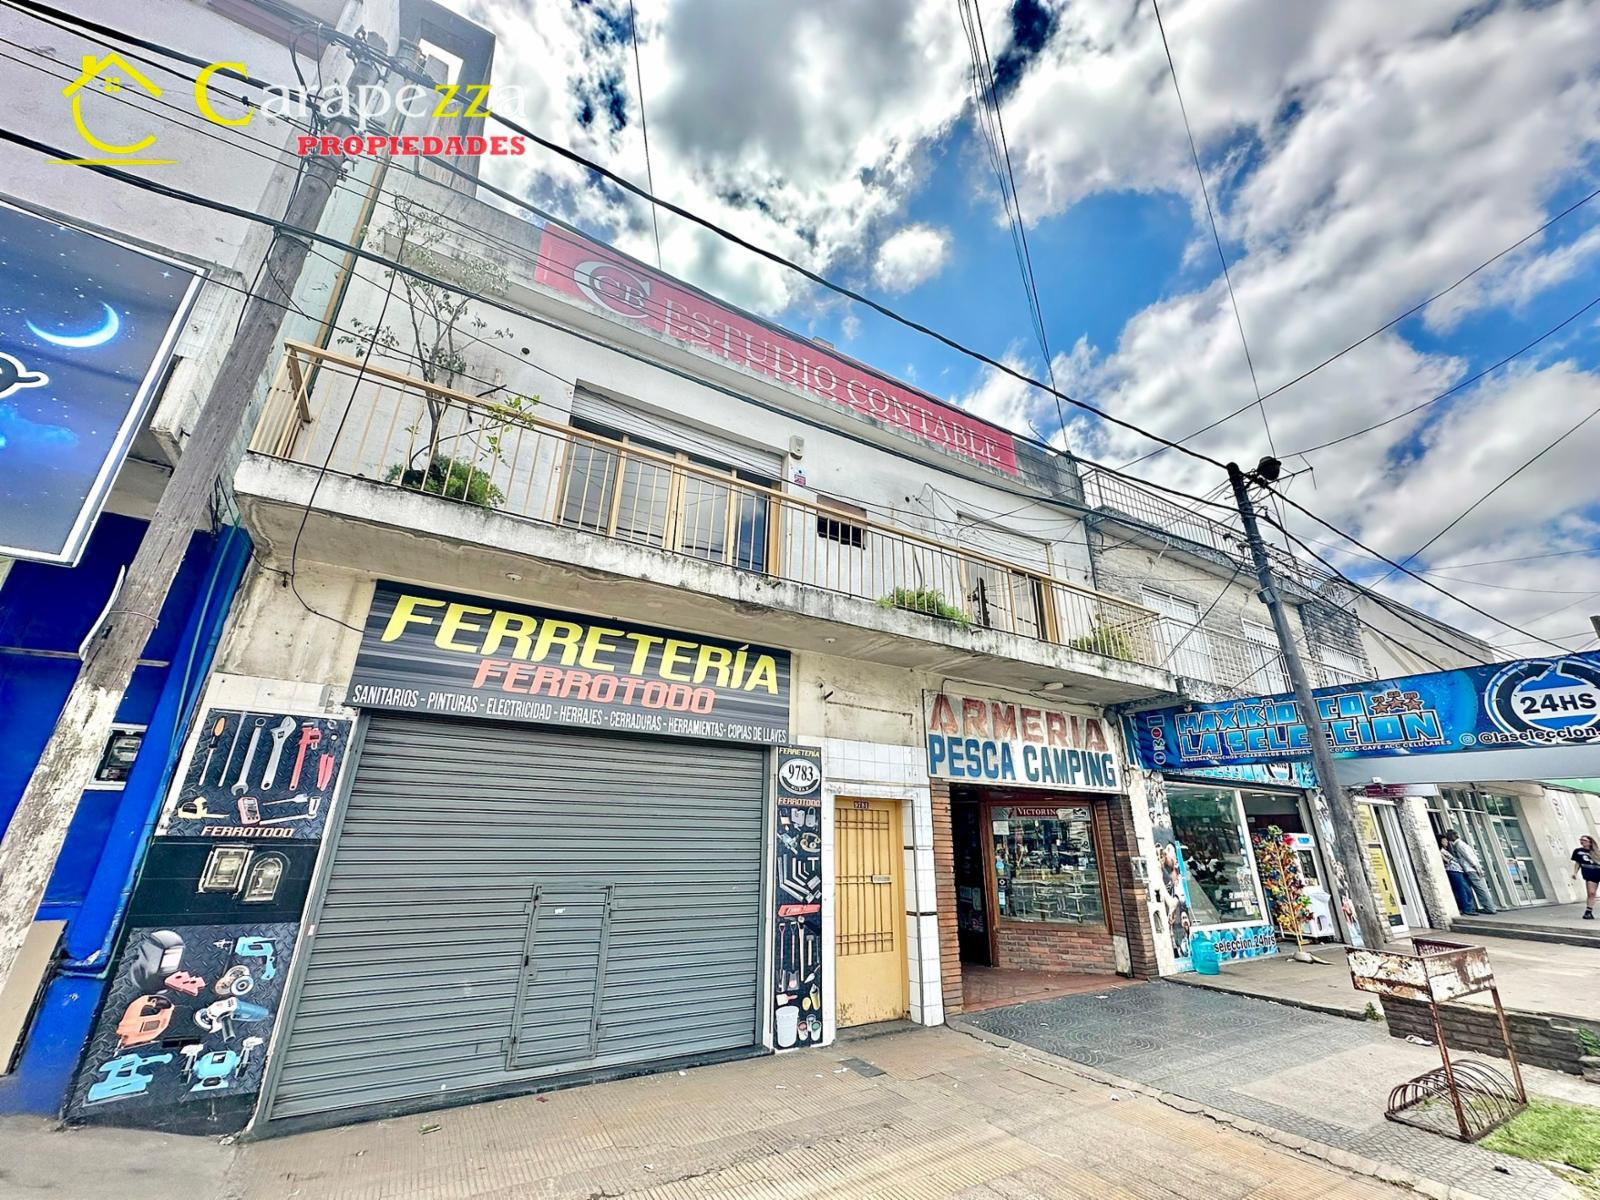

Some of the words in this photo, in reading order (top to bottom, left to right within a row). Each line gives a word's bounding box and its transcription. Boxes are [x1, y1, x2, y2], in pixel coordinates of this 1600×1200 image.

[664, 297, 838, 402] ESTUDIO
[847, 379, 1001, 467] CONTABLE
[381, 594, 779, 695] FERRETERÍA
[473, 660, 716, 714] FERROTODO
[1519, 693, 1598, 714] 24HS
[353, 685, 419, 708] SANITARIOS
[427, 692, 478, 713] PINTURAS
[486, 698, 551, 720] ELECTRICIDAD
[559, 706, 602, 725] HERRAJES
[610, 711, 662, 732] CERRADURAS
[728, 723, 752, 739] COPIAS
[753, 727, 762, 740] DE
[763, 728, 787, 743] LLAVES
[930, 693, 1108, 752] ARMERIA
[1177, 693, 1364, 735] MAXIKIOCO
[1180, 731, 1222, 758] LA
[1226, 711, 1441, 753] SELECION
[789, 764, 814, 782] 9783
[928, 734, 1016, 781] PESCA
[1023, 745, 1116, 787] CAMPING
[778, 797, 821, 807] FERROTODO
[200, 826, 294, 838] FERROTODO
